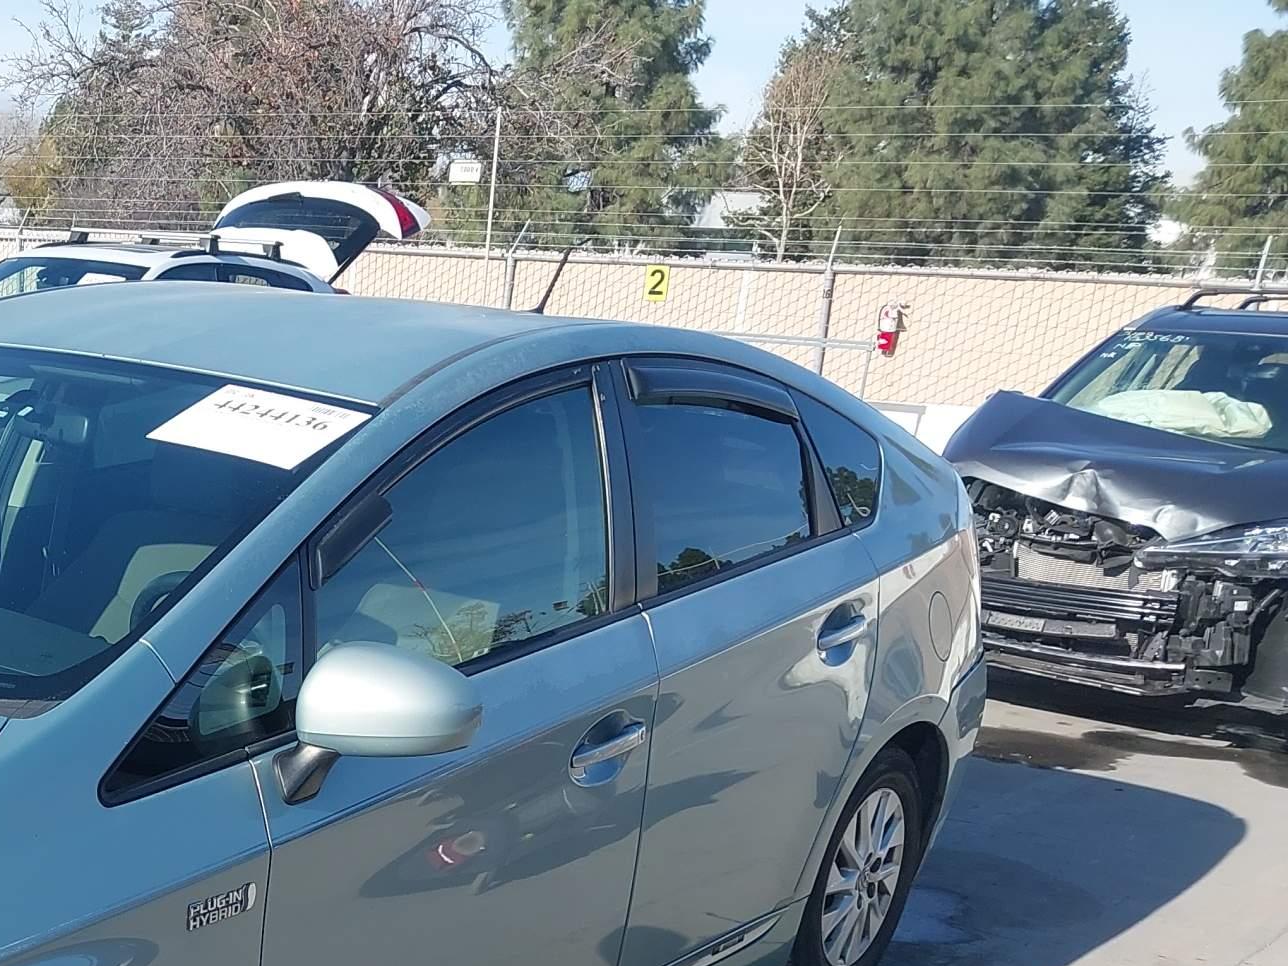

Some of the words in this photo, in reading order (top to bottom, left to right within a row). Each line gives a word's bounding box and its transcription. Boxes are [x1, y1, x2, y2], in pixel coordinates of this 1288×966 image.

[648, 269, 665, 295] 2
[213, 399, 328, 431] 44244136
[189, 903, 241, 931] HYBRID
[190, 888, 243, 918] PLUG-IN
